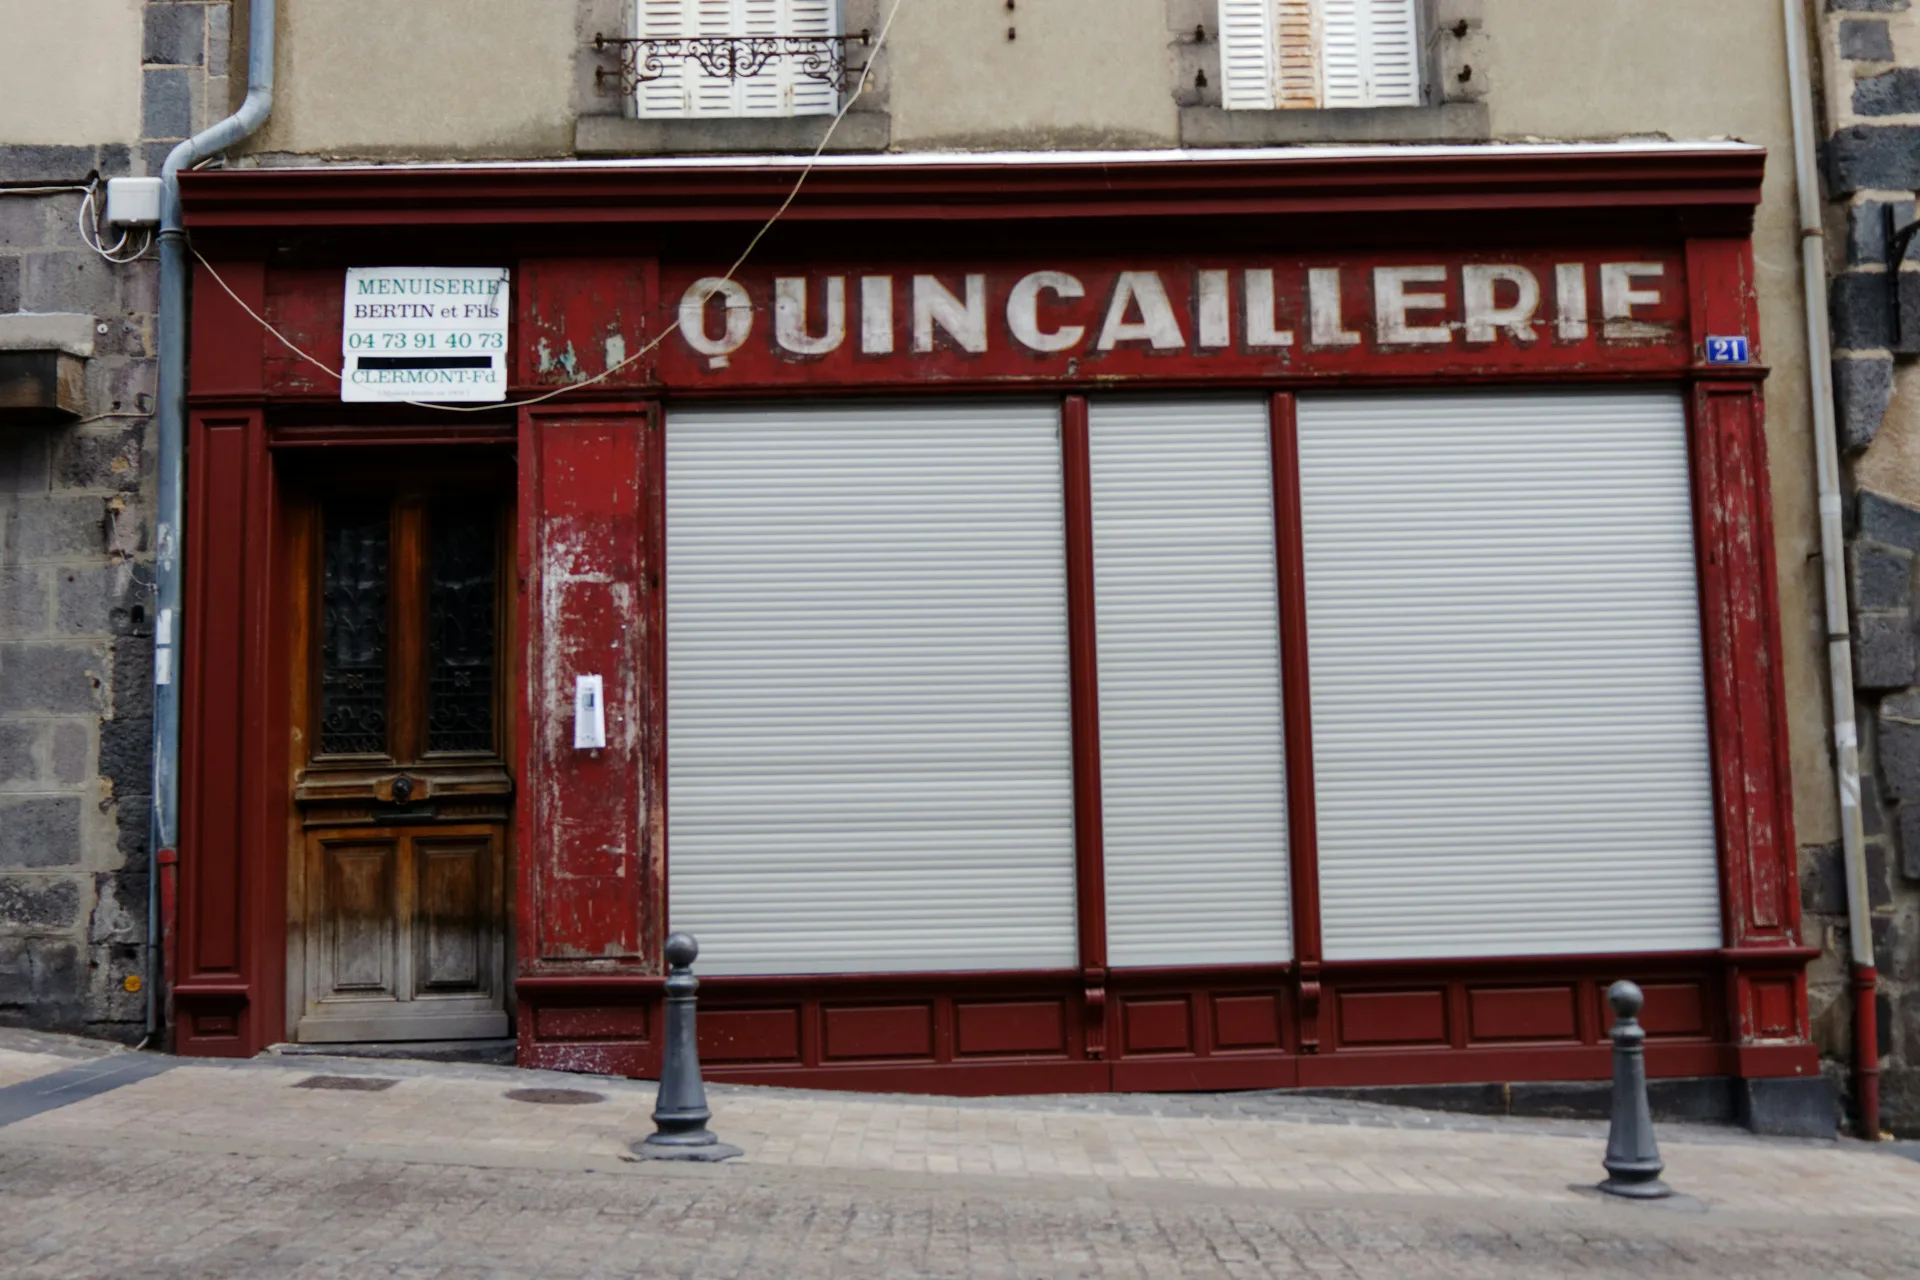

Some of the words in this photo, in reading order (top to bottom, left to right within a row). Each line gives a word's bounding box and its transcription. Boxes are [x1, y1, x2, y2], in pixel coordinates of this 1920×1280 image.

[357, 278, 502, 296] MENUISERIE
[354, 303, 435, 319] BERTIN
[440, 304, 459, 319] et
[463, 303, 500, 319] Fils
[678, 261, 1671, 369] QUINCAILLERIE
[349, 332, 375, 349] 04
[382, 332, 407, 349] 73
[413, 332, 436, 349] 91
[444, 332, 472, 349] 40
[478, 332, 503, 349] 73
[1713, 339, 1739, 361] 21
[351, 369, 497, 384] CLERMONT-Fd
